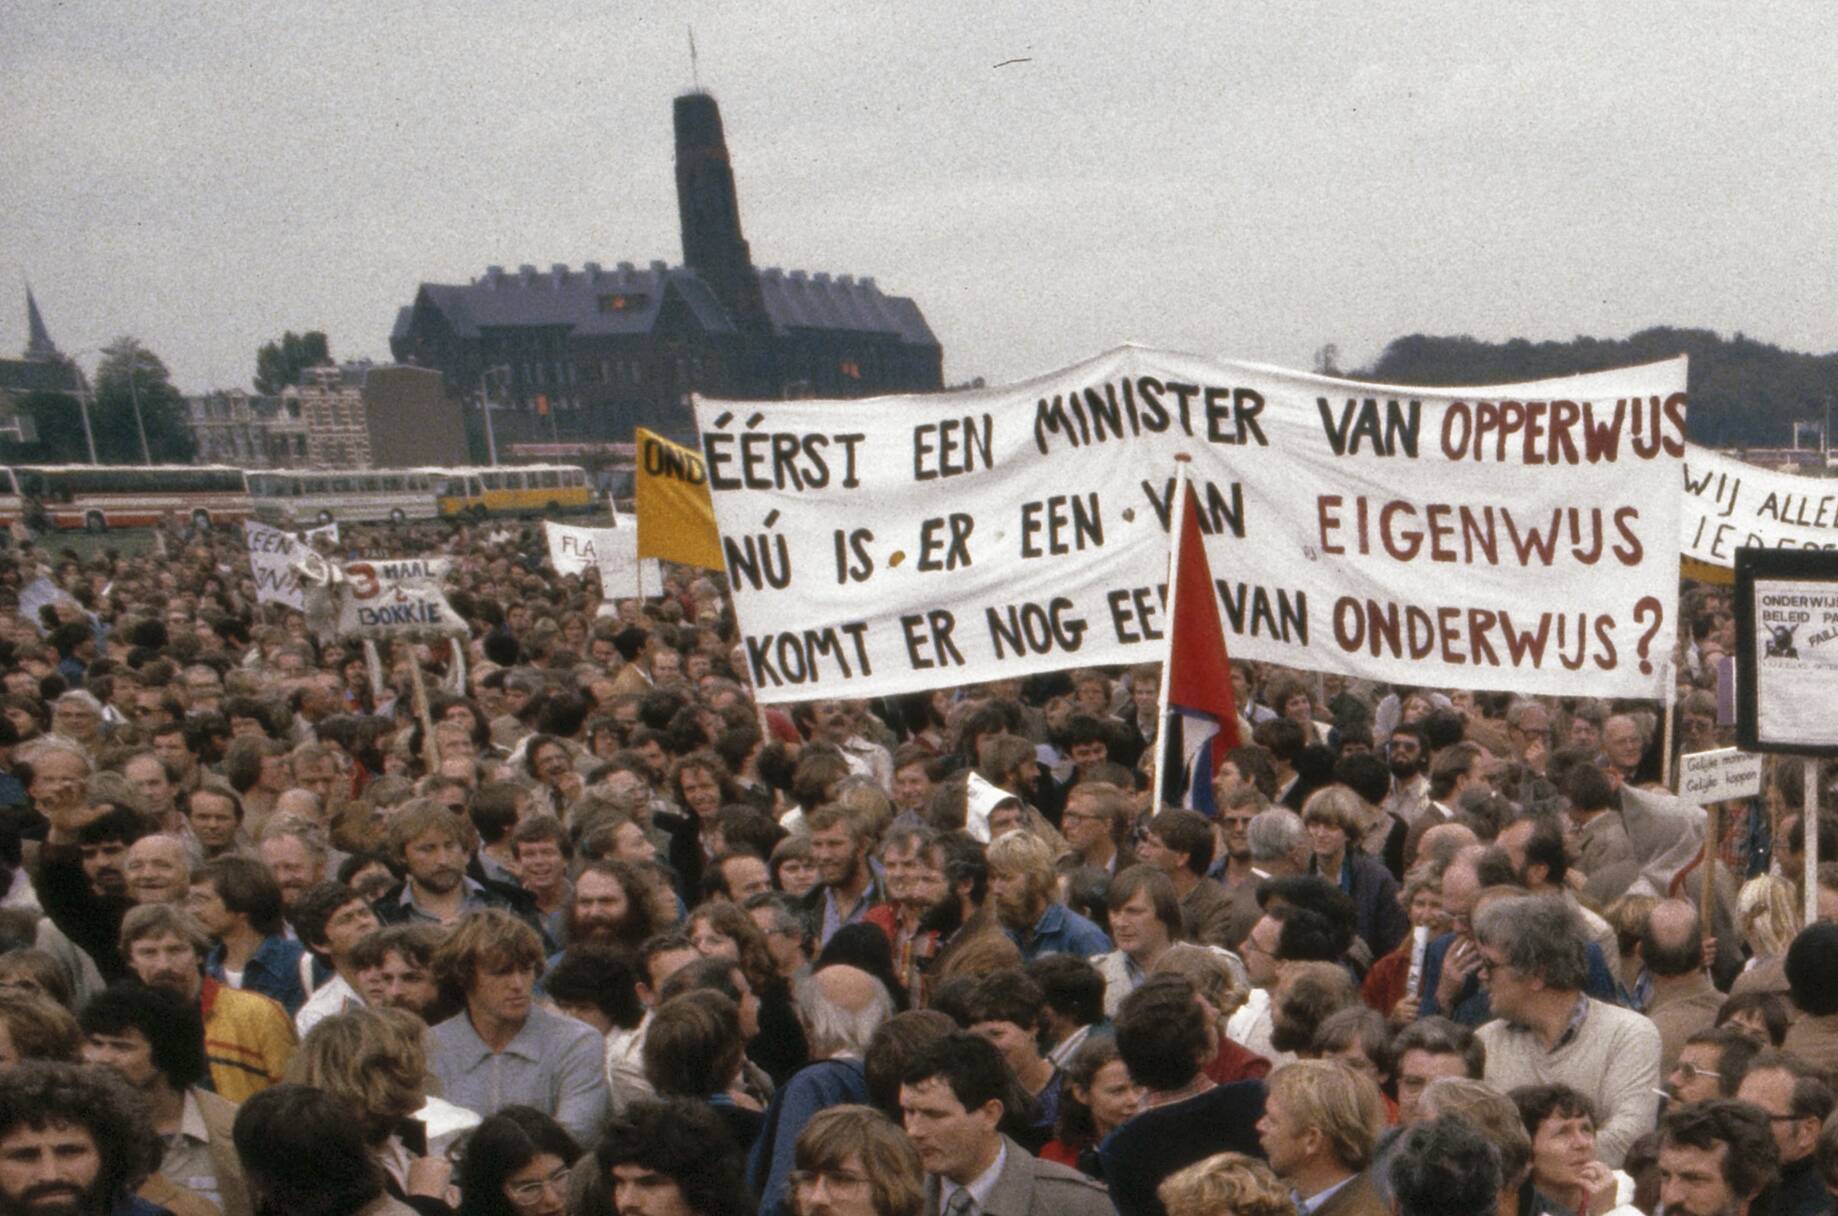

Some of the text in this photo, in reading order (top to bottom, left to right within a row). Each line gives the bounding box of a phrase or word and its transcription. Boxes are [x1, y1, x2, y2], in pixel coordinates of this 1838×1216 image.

[703, 376, 1688, 491] ÉÉRST EEN MINISTER VAN OPPERWIJS
[1683, 463, 1741, 517] WIJ
[348, 563, 380, 599] 3
[384, 561, 436, 580] MAAL
[723, 508, 793, 592] NÚ
[833, 528, 875, 586] IS
[916, 512, 975, 572] ER
[1020, 492, 1105, 560] EEN
[1317, 495, 1643, 567] EIGENWIJS
[746, 622, 873, 689] KOMT
[901, 609, 965, 671] ER
[987, 596, 1088, 661] NOG
[1107, 584, 1168, 645] EE
[1216, 579, 1308, 647] VAN
[1763, 611, 1810, 624] BELEID
